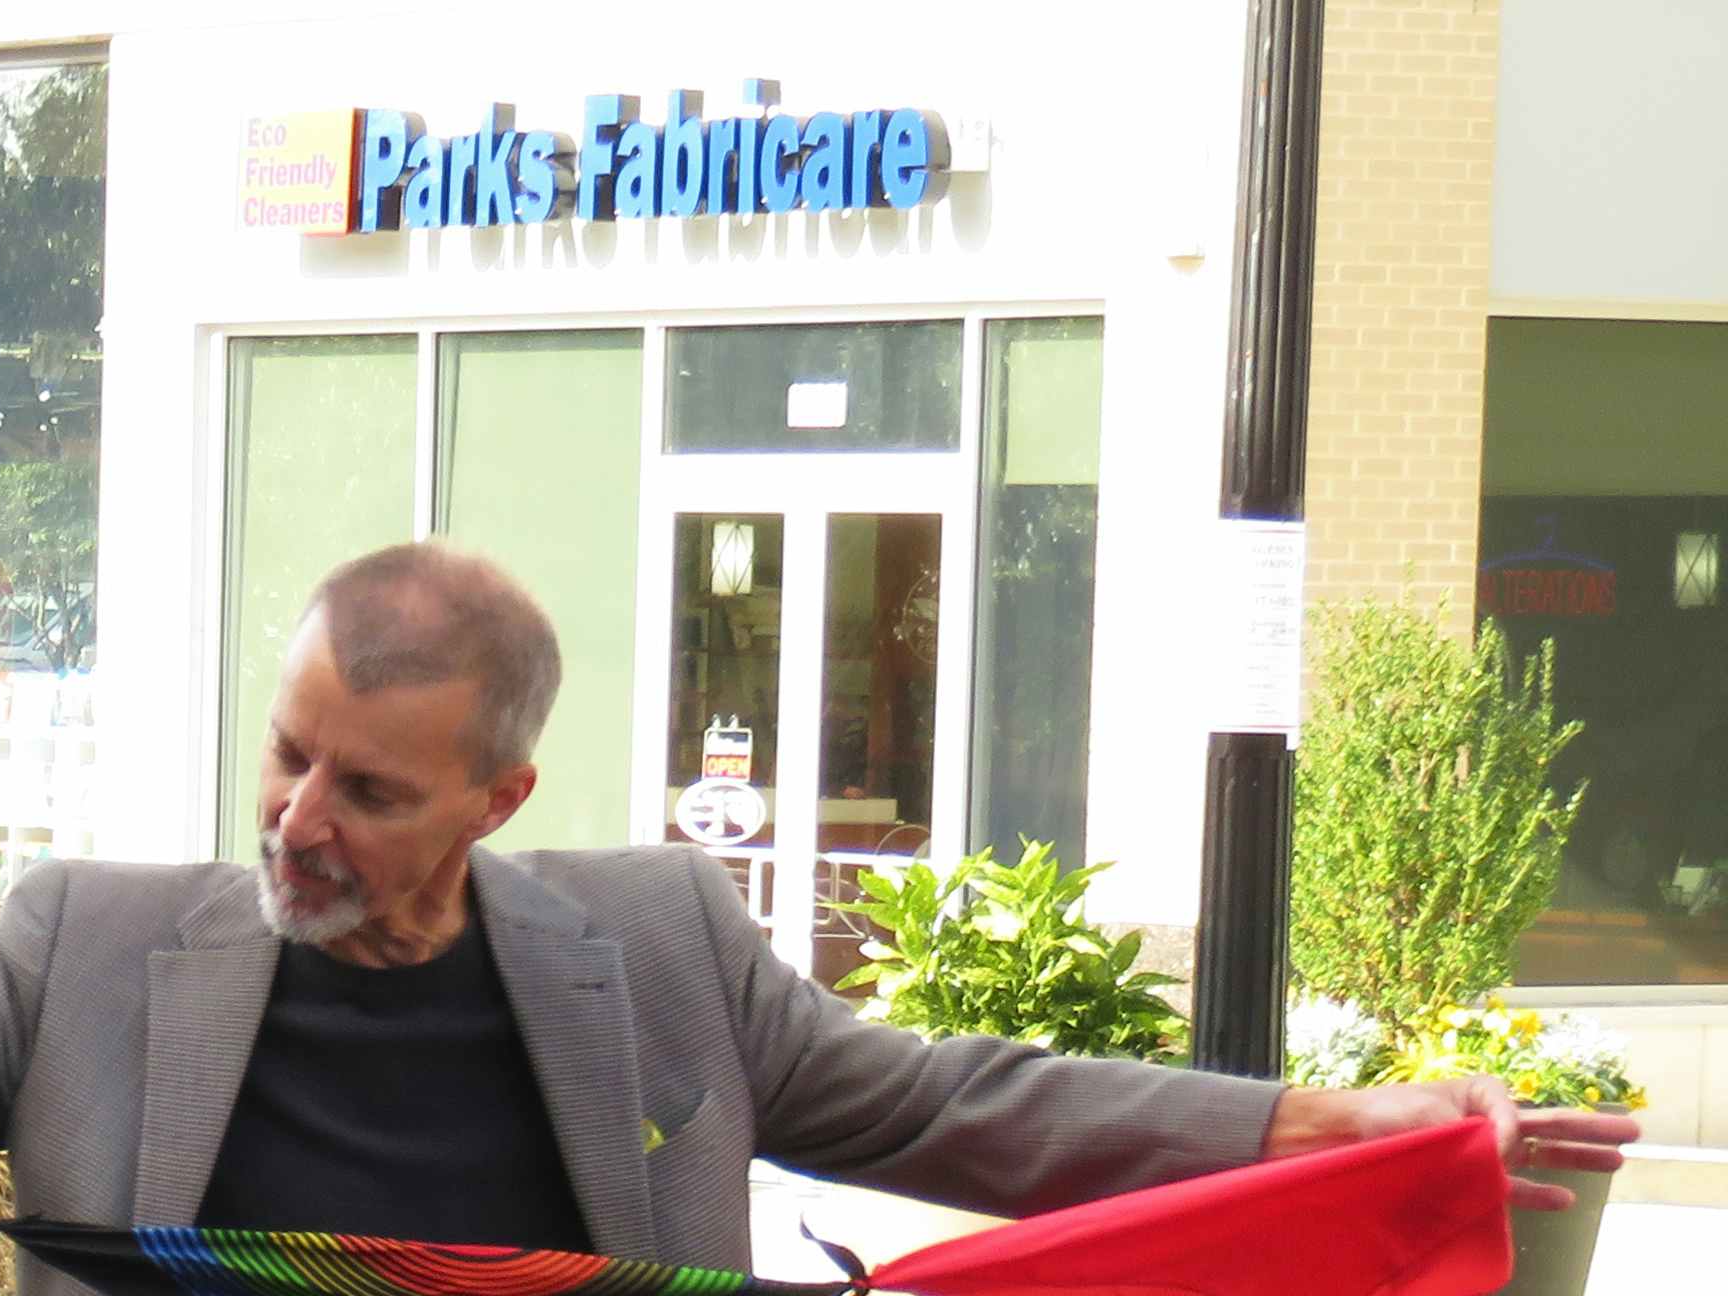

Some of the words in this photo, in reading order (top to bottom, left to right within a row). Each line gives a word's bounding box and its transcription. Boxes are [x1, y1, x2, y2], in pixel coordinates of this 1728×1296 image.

[247, 117, 287, 147] Eco
[360, 102, 560, 232] Parks
[578, 78, 930, 220] Fabricare
[246, 154, 337, 190] Friendly
[244, 197, 344, 227] Cleaners
